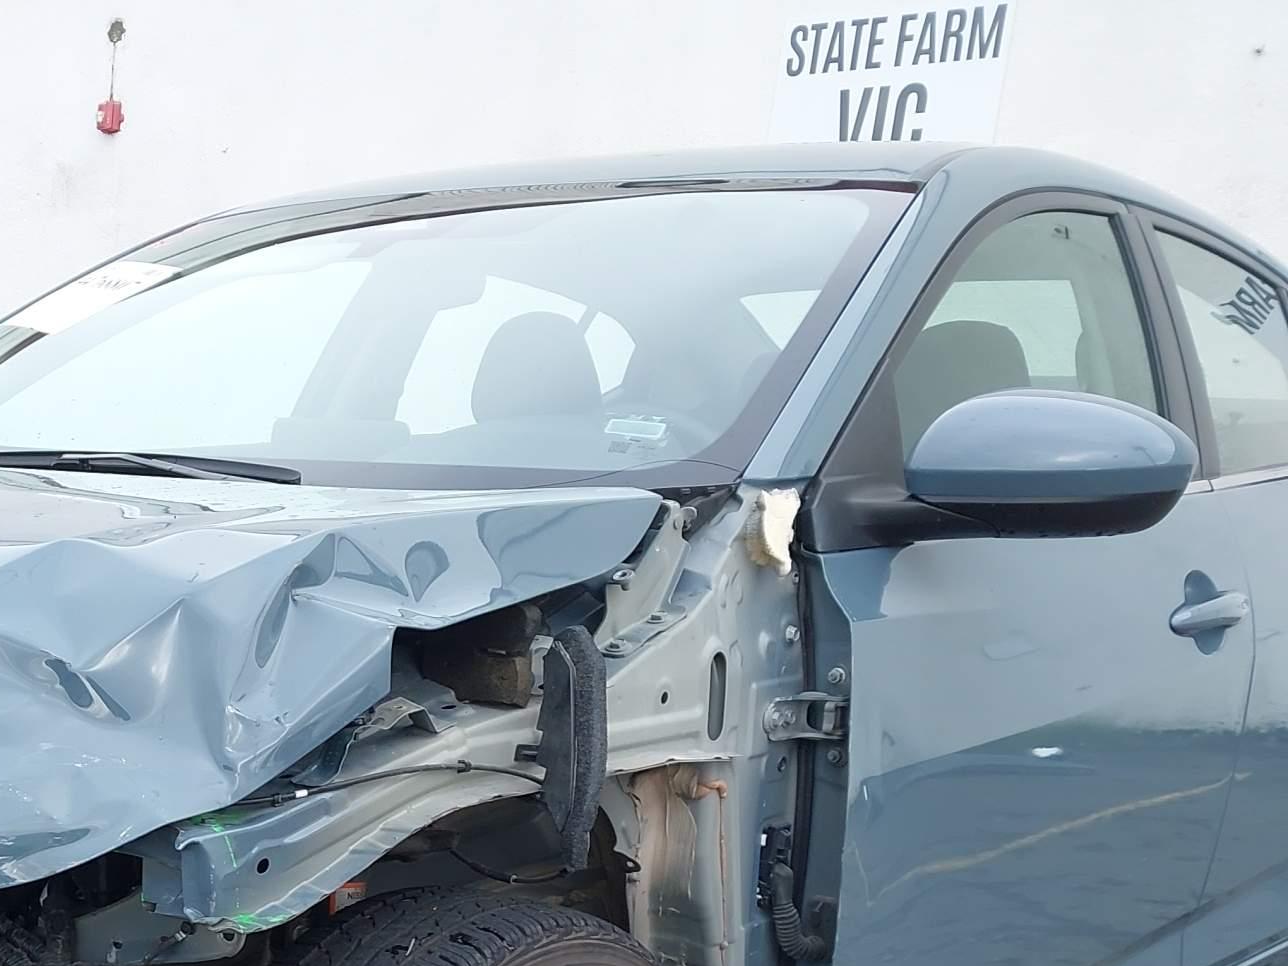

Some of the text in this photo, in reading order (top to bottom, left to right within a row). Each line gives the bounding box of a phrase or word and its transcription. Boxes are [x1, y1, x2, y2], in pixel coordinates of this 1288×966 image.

[786, 3, 1008, 77] STATE FARM
[839, 82, 928, 141] VIC
